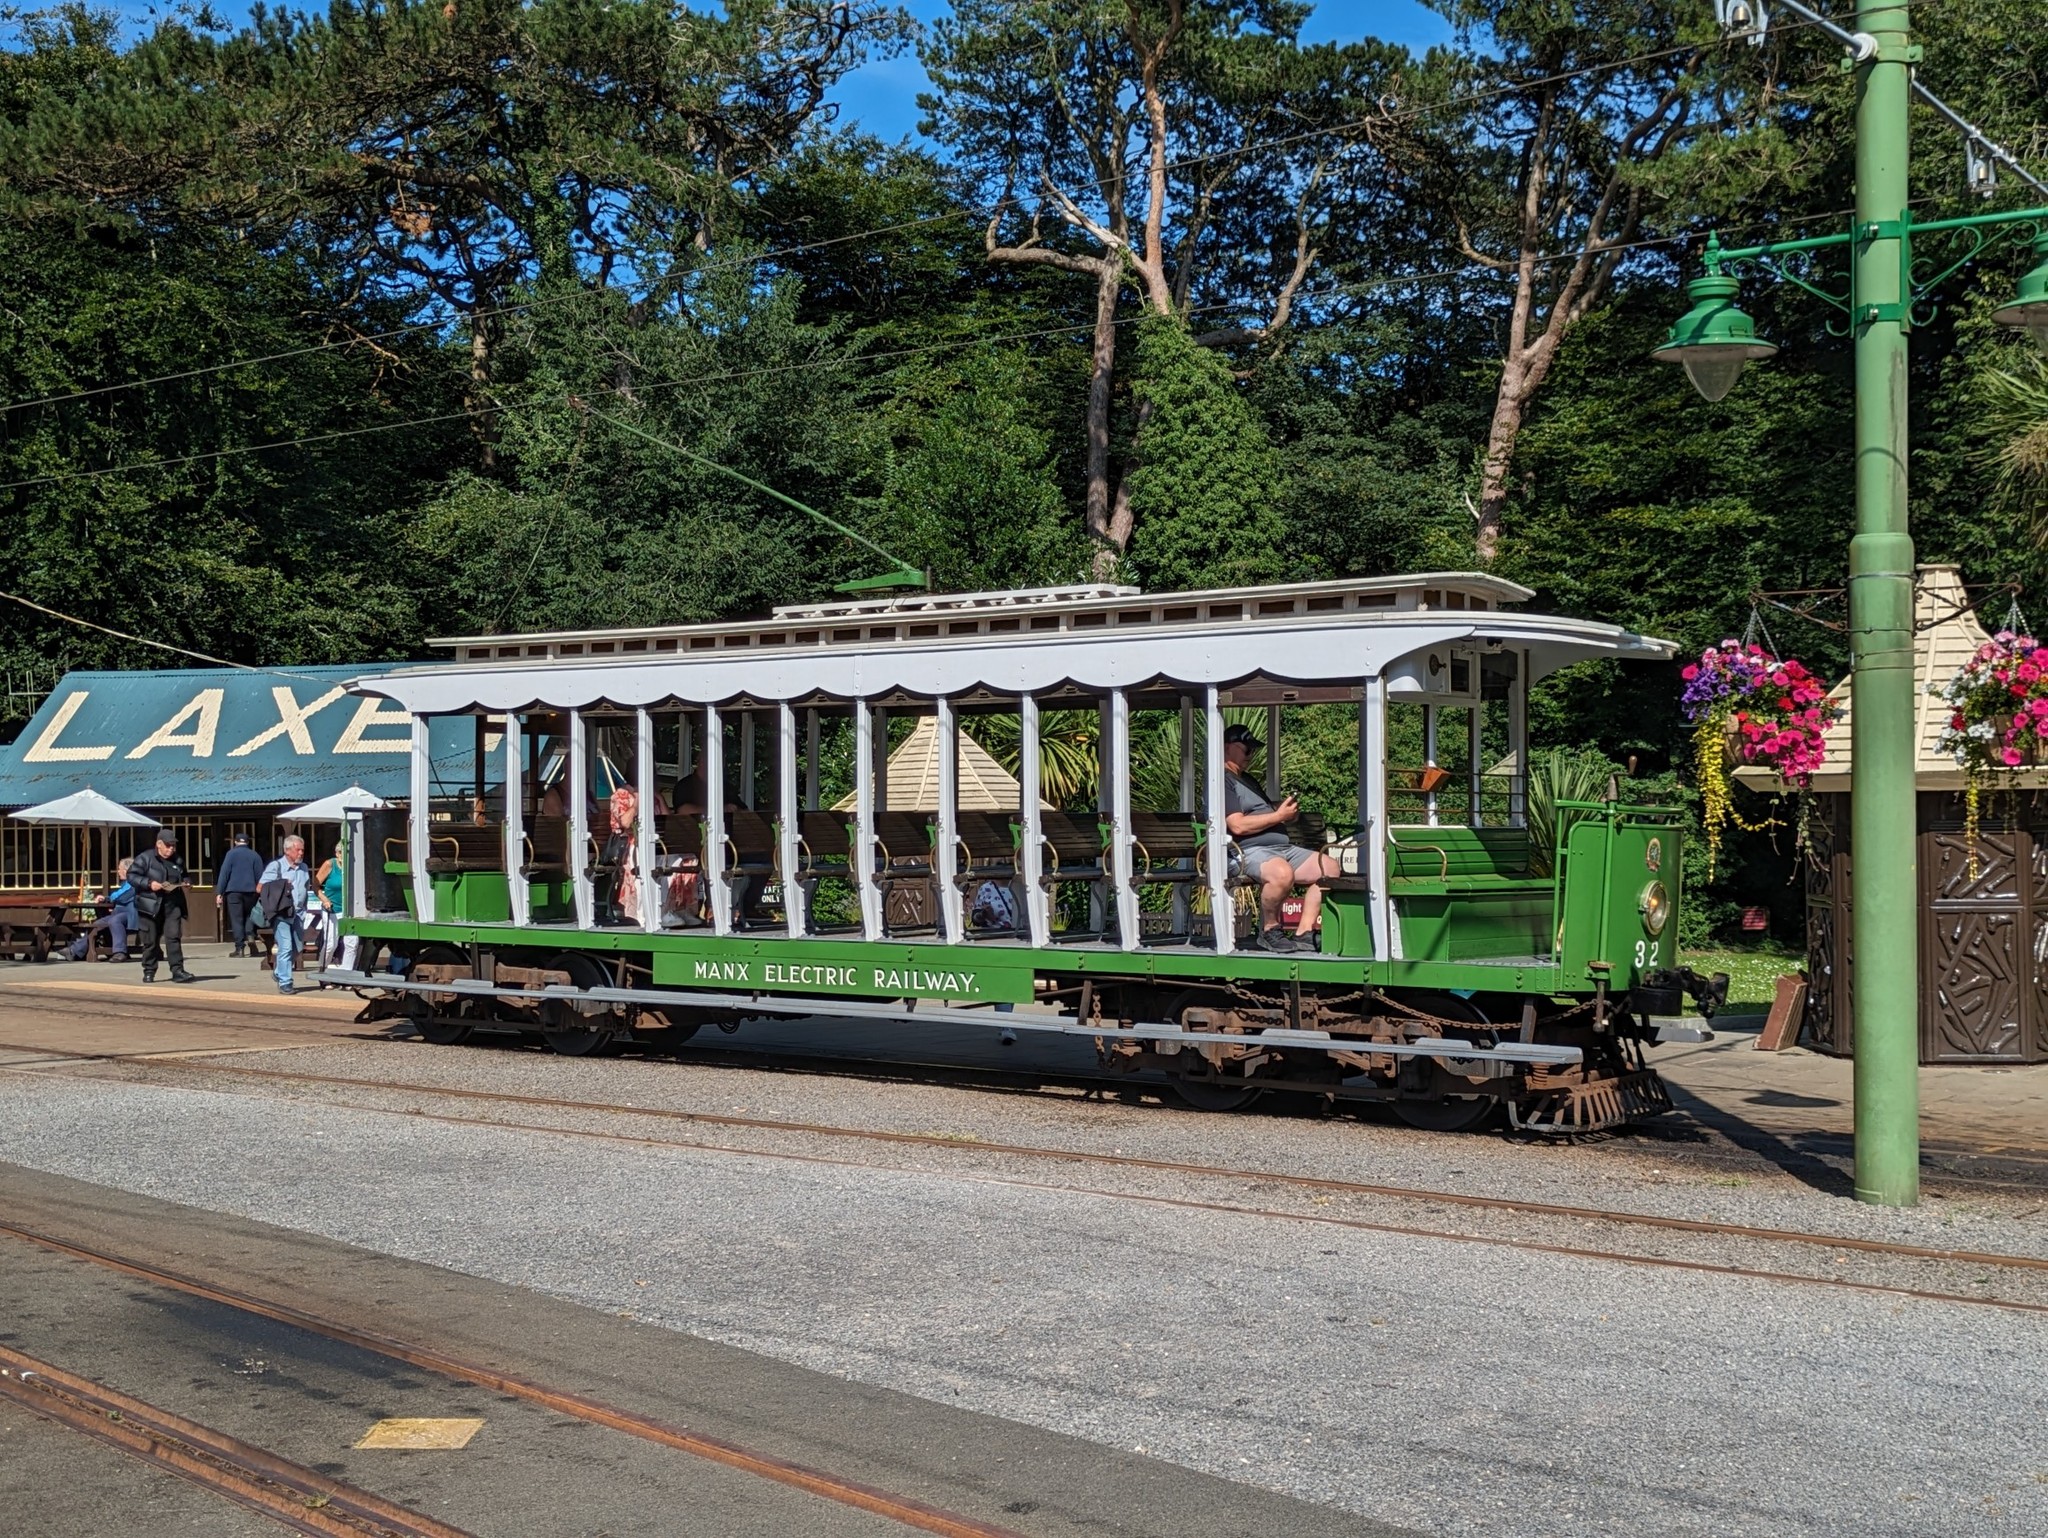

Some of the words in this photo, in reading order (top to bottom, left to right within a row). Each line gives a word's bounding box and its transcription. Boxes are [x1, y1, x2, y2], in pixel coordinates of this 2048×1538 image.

[23, 686, 503, 762] LAXE
[761, 895, 780, 903] ONLY
[1635, 940, 1659, 968] 32
[694, 960, 751, 981] MANX
[764, 963, 858, 986] ELECTRIC
[873, 968, 982, 994] RAILWAY.
